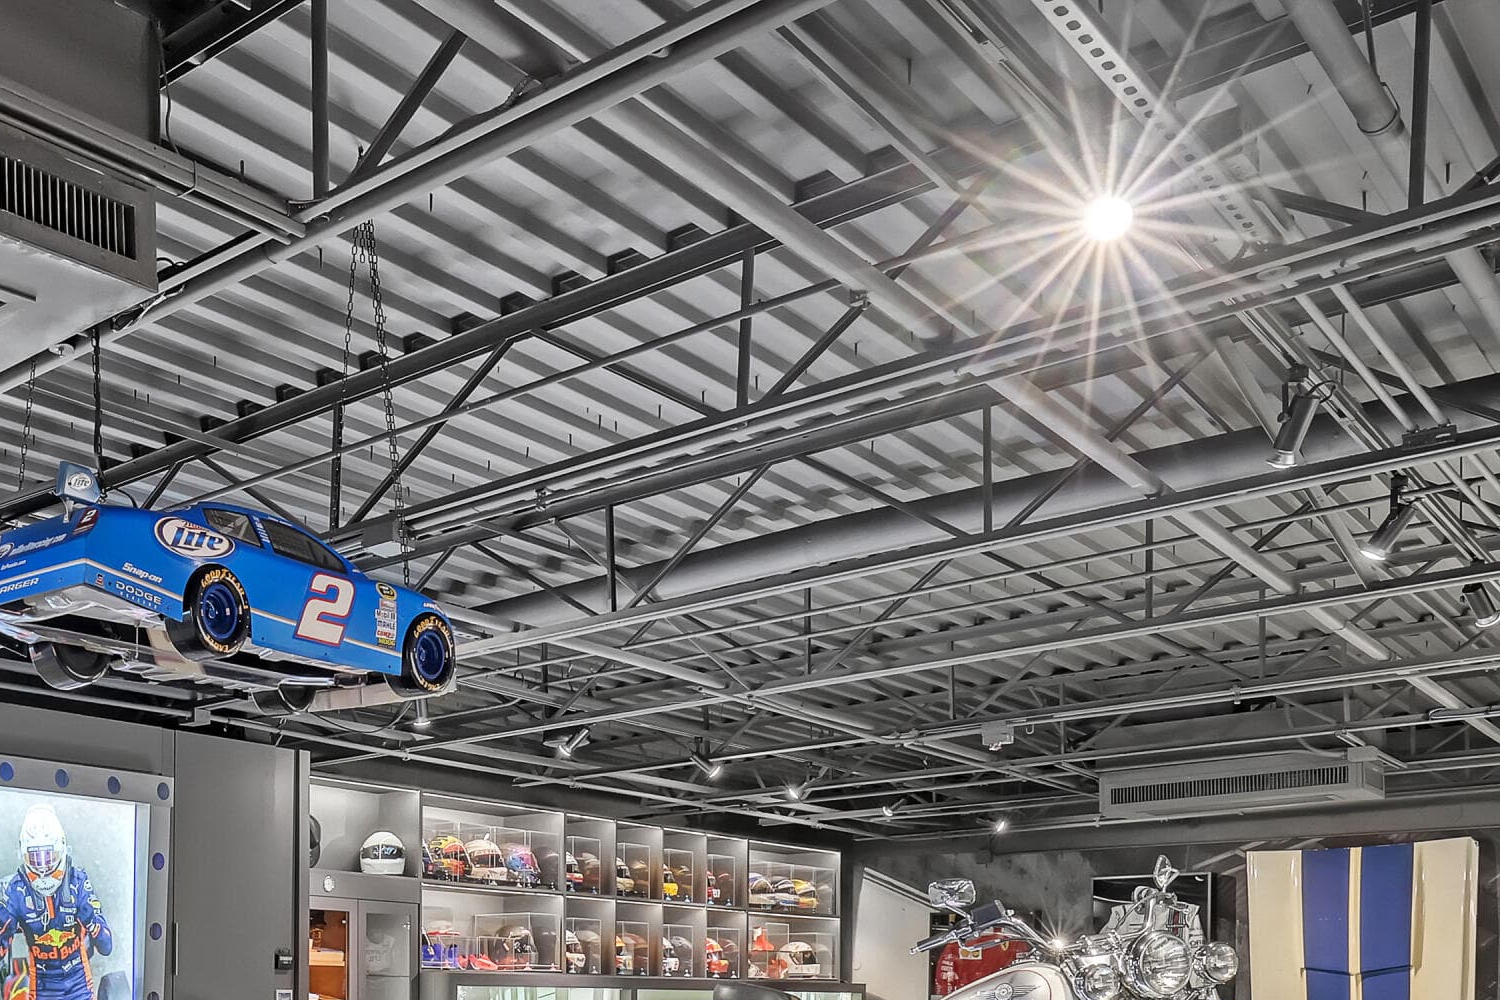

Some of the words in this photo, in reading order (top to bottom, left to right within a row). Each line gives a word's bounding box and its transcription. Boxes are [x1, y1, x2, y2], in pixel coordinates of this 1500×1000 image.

[82, 510, 97, 523] 2
[171, 525, 224, 551] Lite
[122, 562, 162, 583] Snap-on
[115, 581, 162, 605] DODGE
[297, 572, 356, 646] 2
[32, 946, 58, 960] Red
